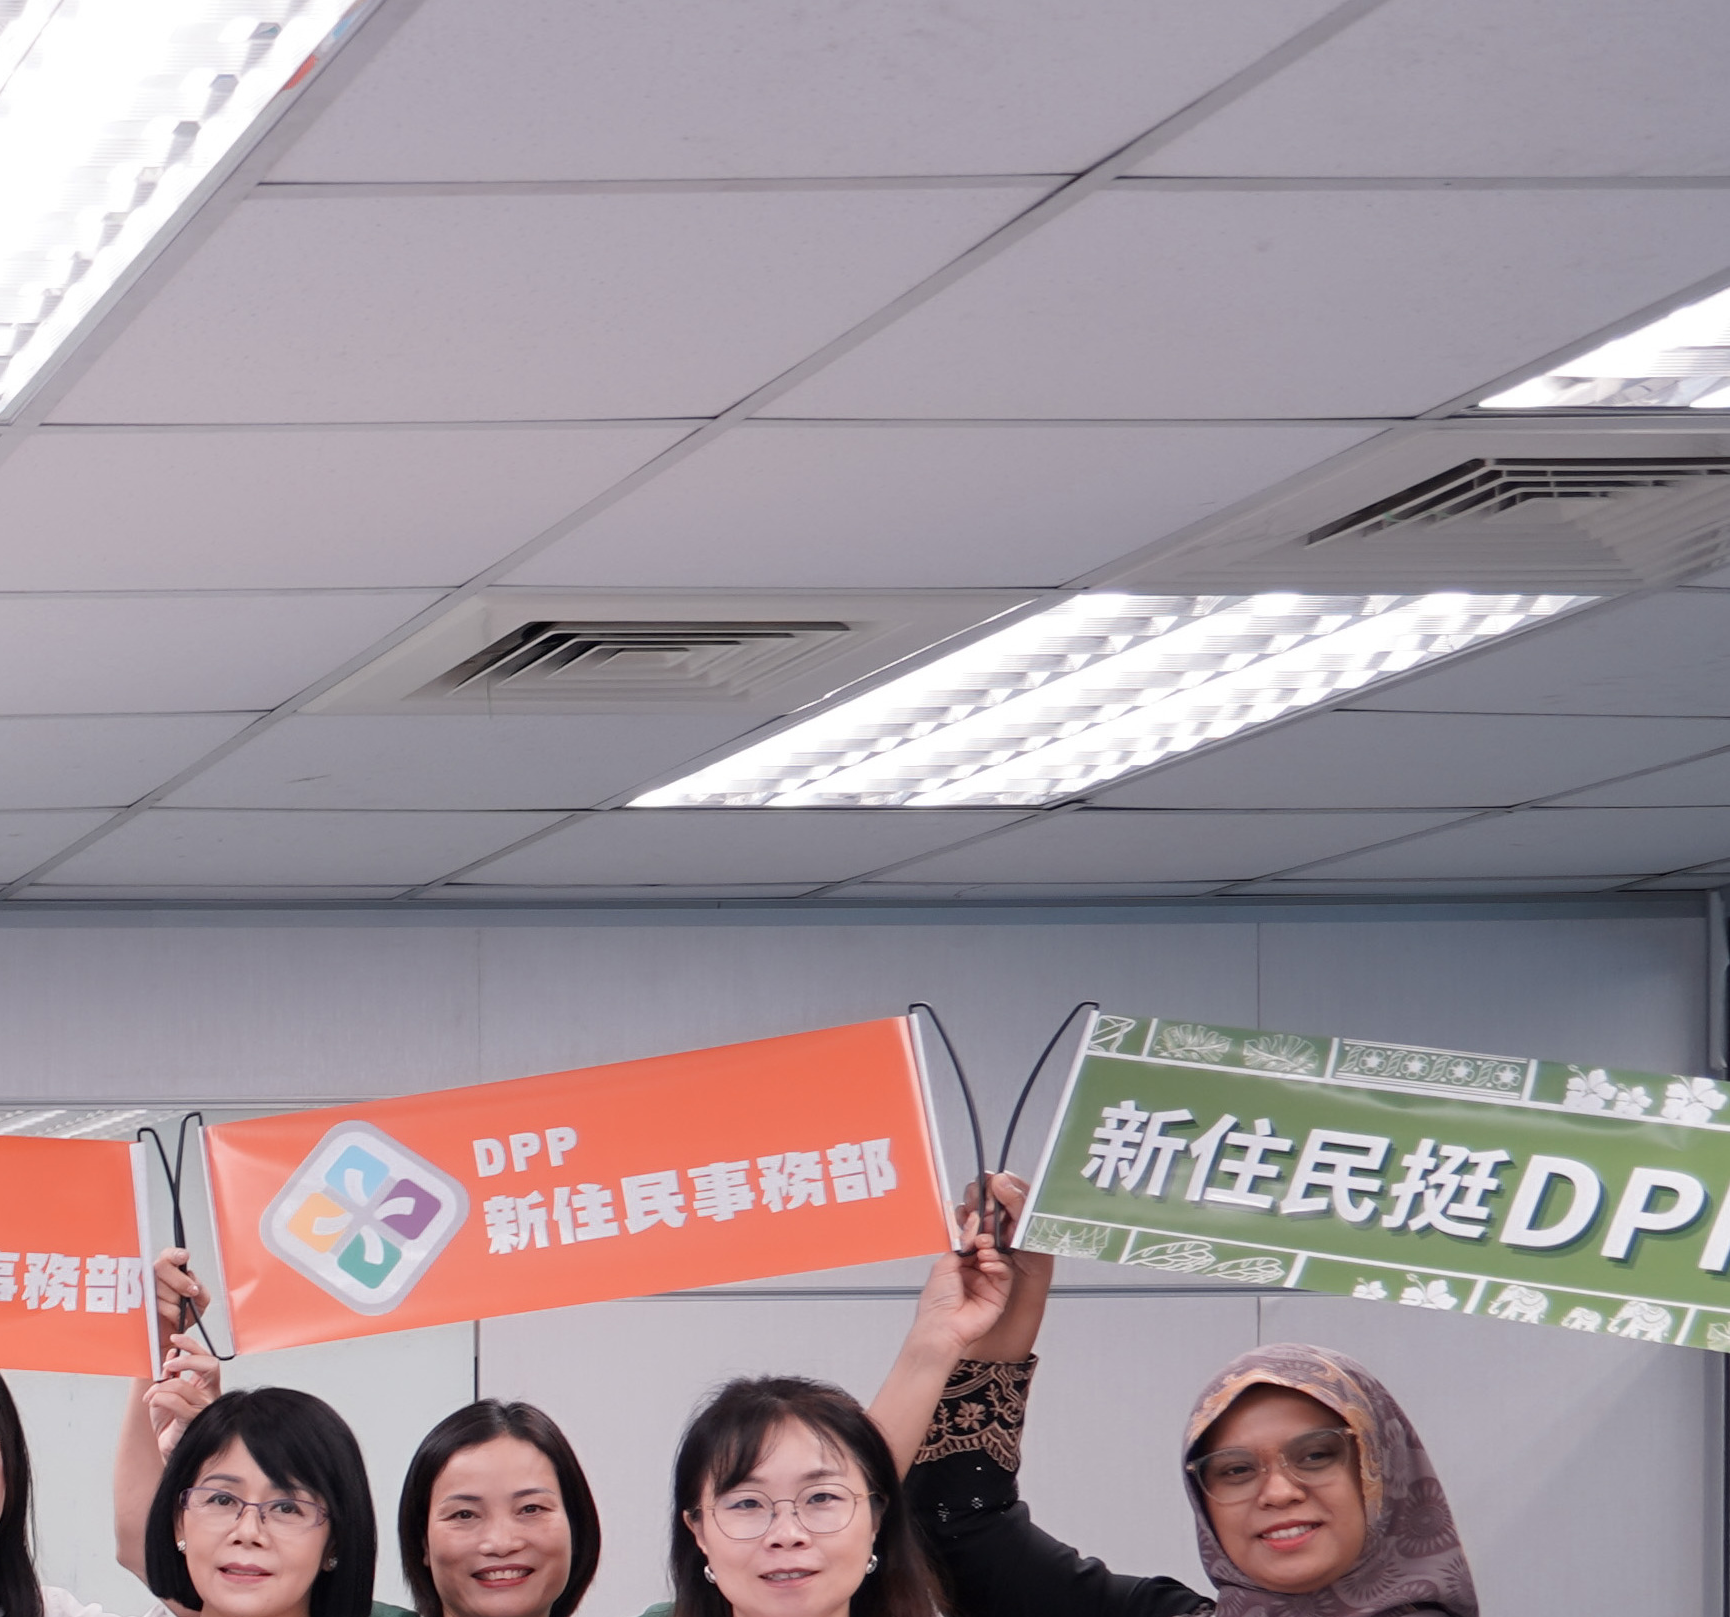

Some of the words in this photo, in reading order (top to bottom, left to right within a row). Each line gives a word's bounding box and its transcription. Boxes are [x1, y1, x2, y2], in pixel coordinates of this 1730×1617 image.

[472, 1125, 578, 1178] DPP
[483, 1137, 898, 1254] 新住民事務部
